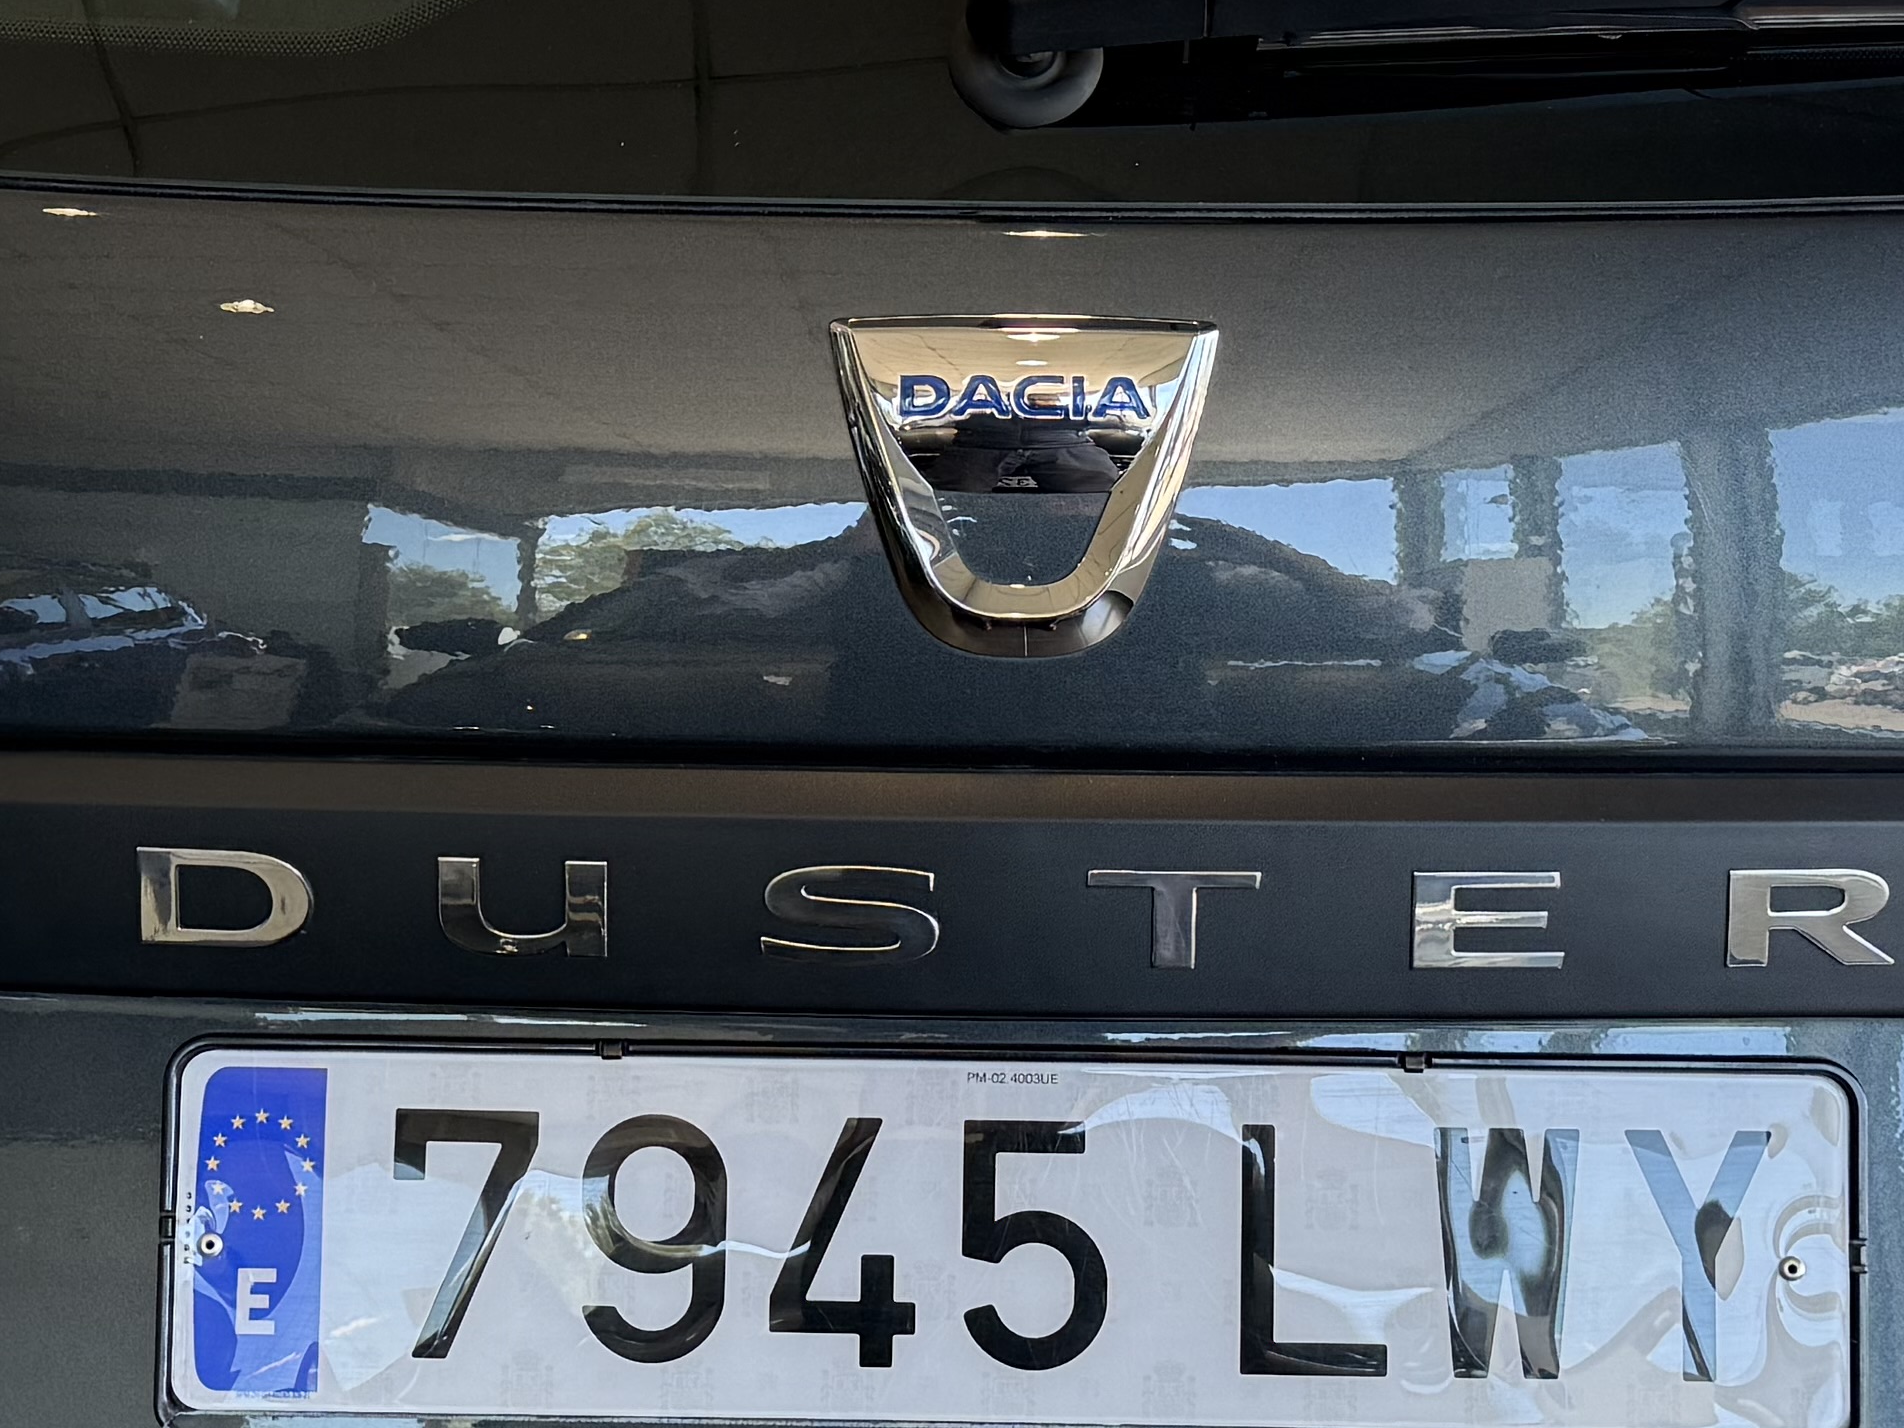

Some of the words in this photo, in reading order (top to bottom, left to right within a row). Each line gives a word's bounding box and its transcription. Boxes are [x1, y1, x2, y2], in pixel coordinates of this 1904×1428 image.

[897, 374, 1150, 420] DACIA
[136, 846, 1896, 971] DUSTER
[392, 1108, 1108, 1370] 7945
[1239, 1123, 1774, 1382] LWY
[235, 1267, 276, 1336] E
